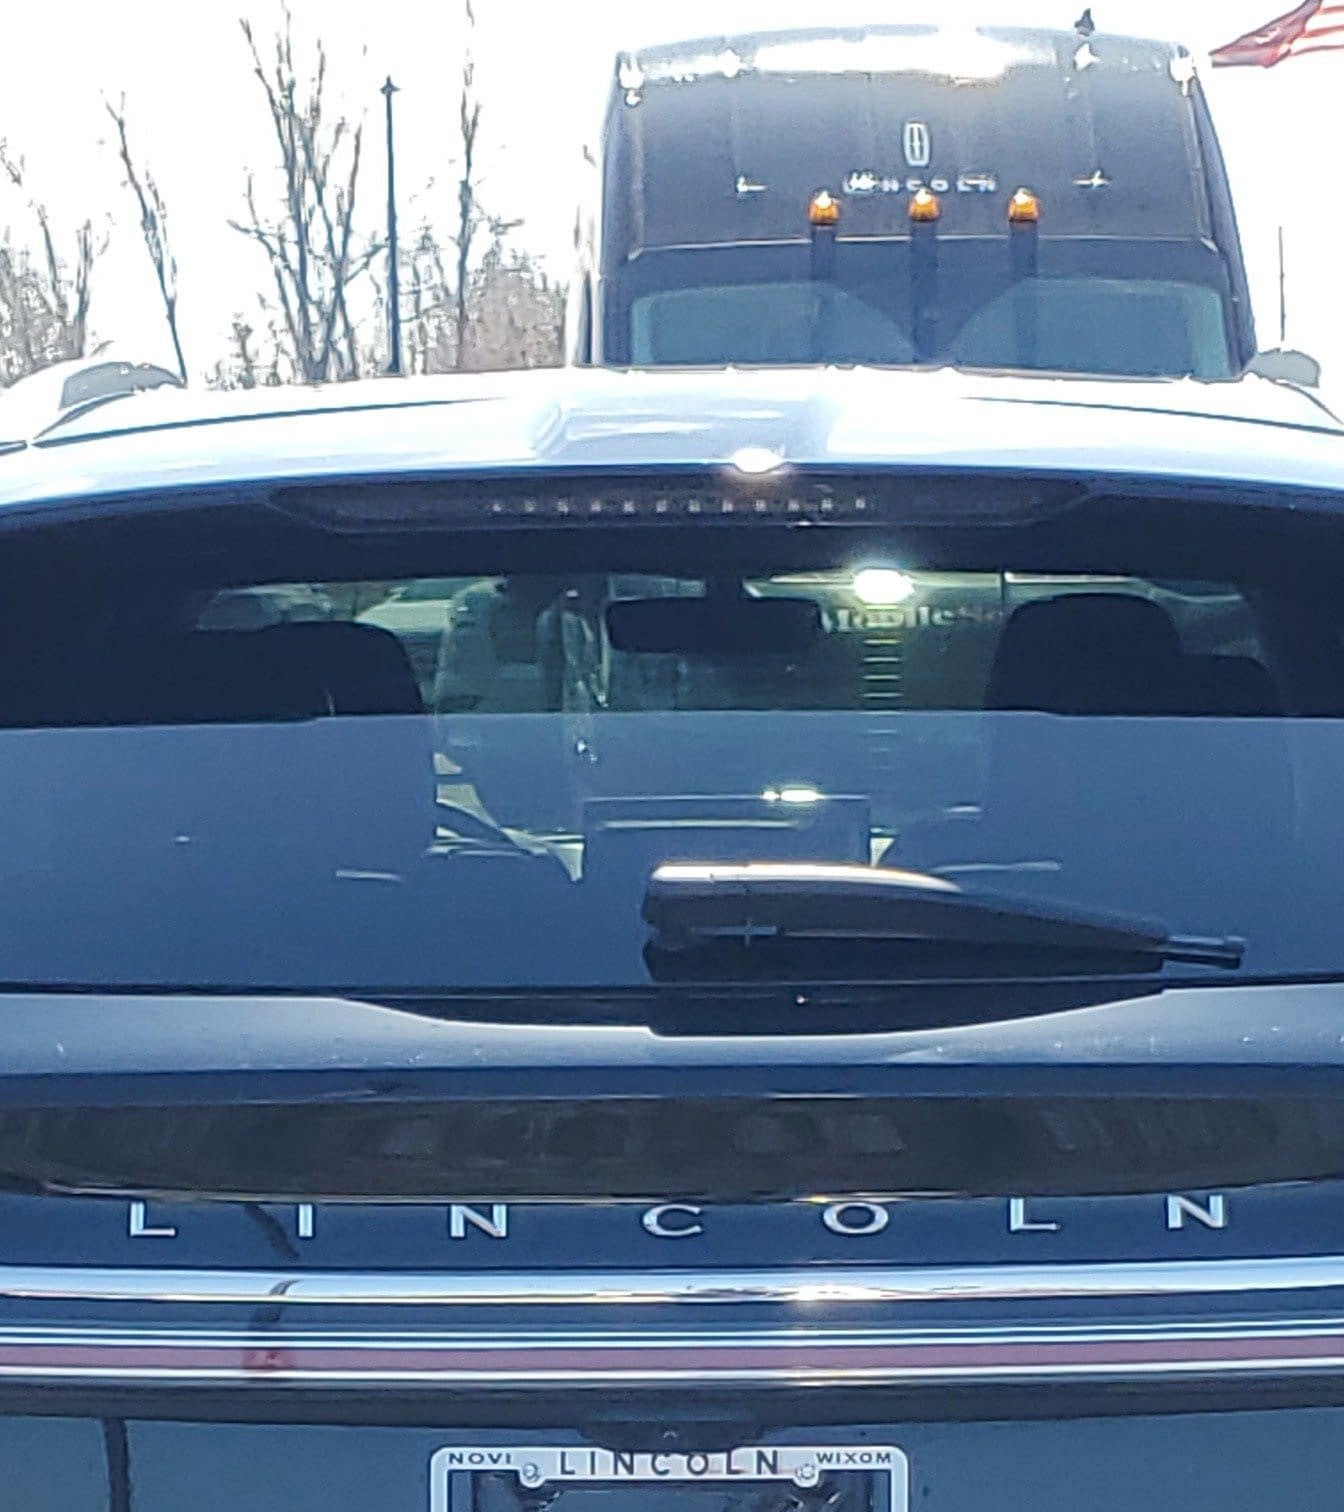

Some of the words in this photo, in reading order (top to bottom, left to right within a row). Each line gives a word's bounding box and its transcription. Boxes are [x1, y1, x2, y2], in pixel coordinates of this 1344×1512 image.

[130, 1193, 1228, 1239] LINCOLN
[448, 1452, 512, 1465] NOVI
[560, 1450, 779, 1476] LINCOLN
[816, 1452, 892, 1464] WIXOM
